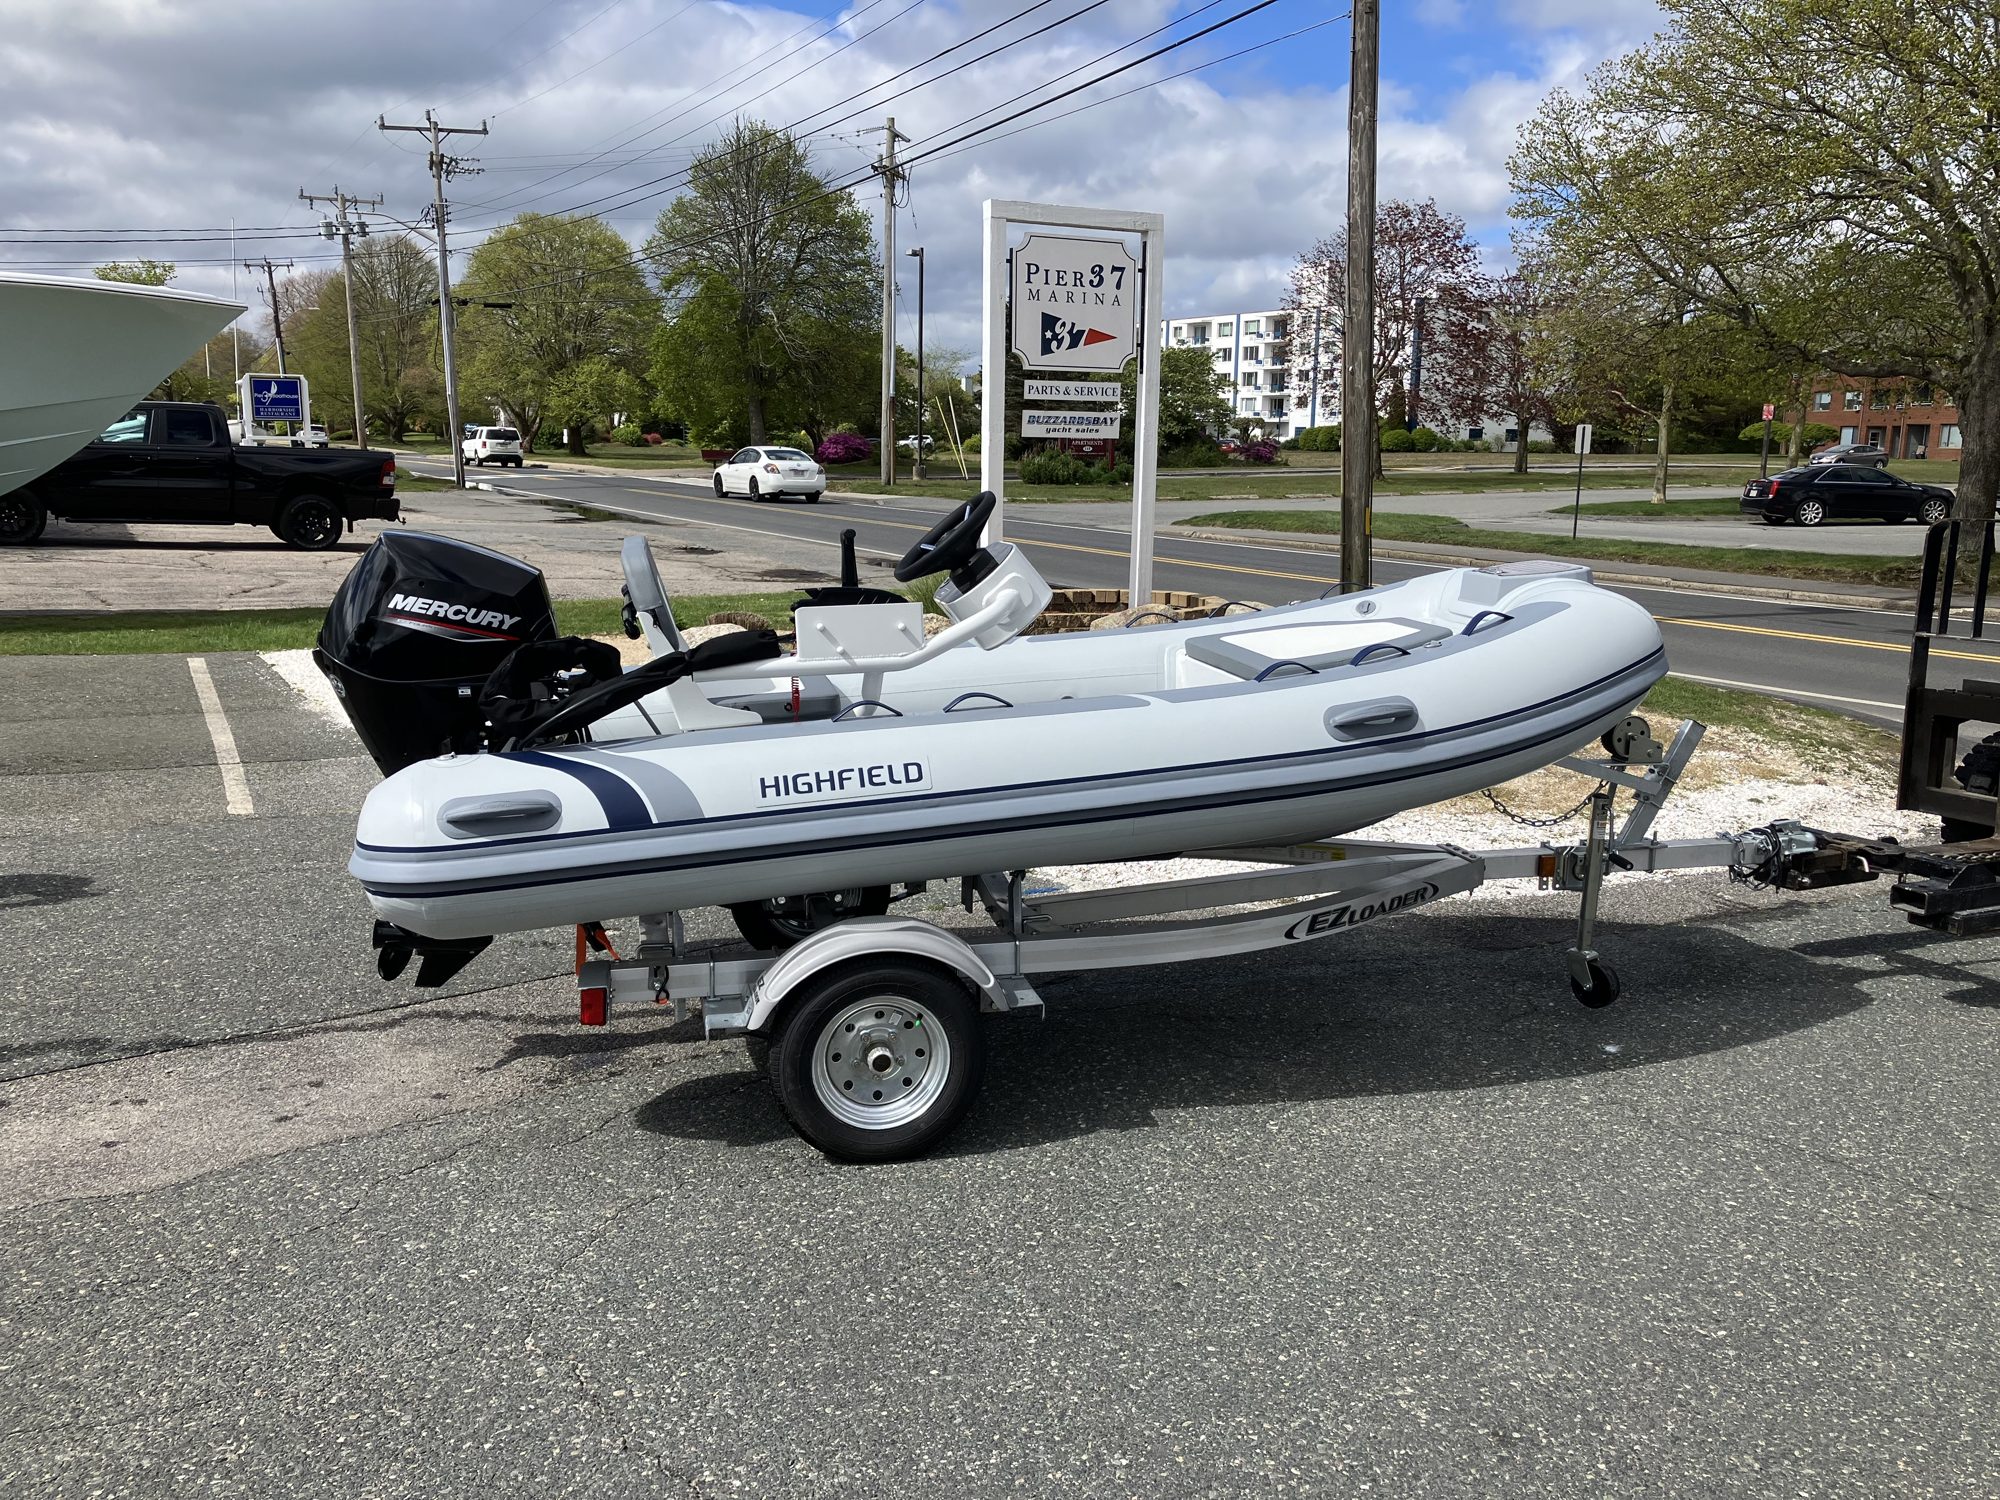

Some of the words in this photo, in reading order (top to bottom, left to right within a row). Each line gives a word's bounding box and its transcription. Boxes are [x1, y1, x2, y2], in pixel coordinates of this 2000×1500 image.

[1088, 264, 1126, 291] 37
[1027, 288, 1121, 307] MARINA
[1028, 384, 1060, 396] PARTS
[1063, 385, 1071, 396] &
[1074, 386, 1119, 397] SERVICE
[1046, 426, 1072, 434] yacht
[387, 593, 522, 630] MERCURY
[759, 762, 924, 799] HIGHFIELD
